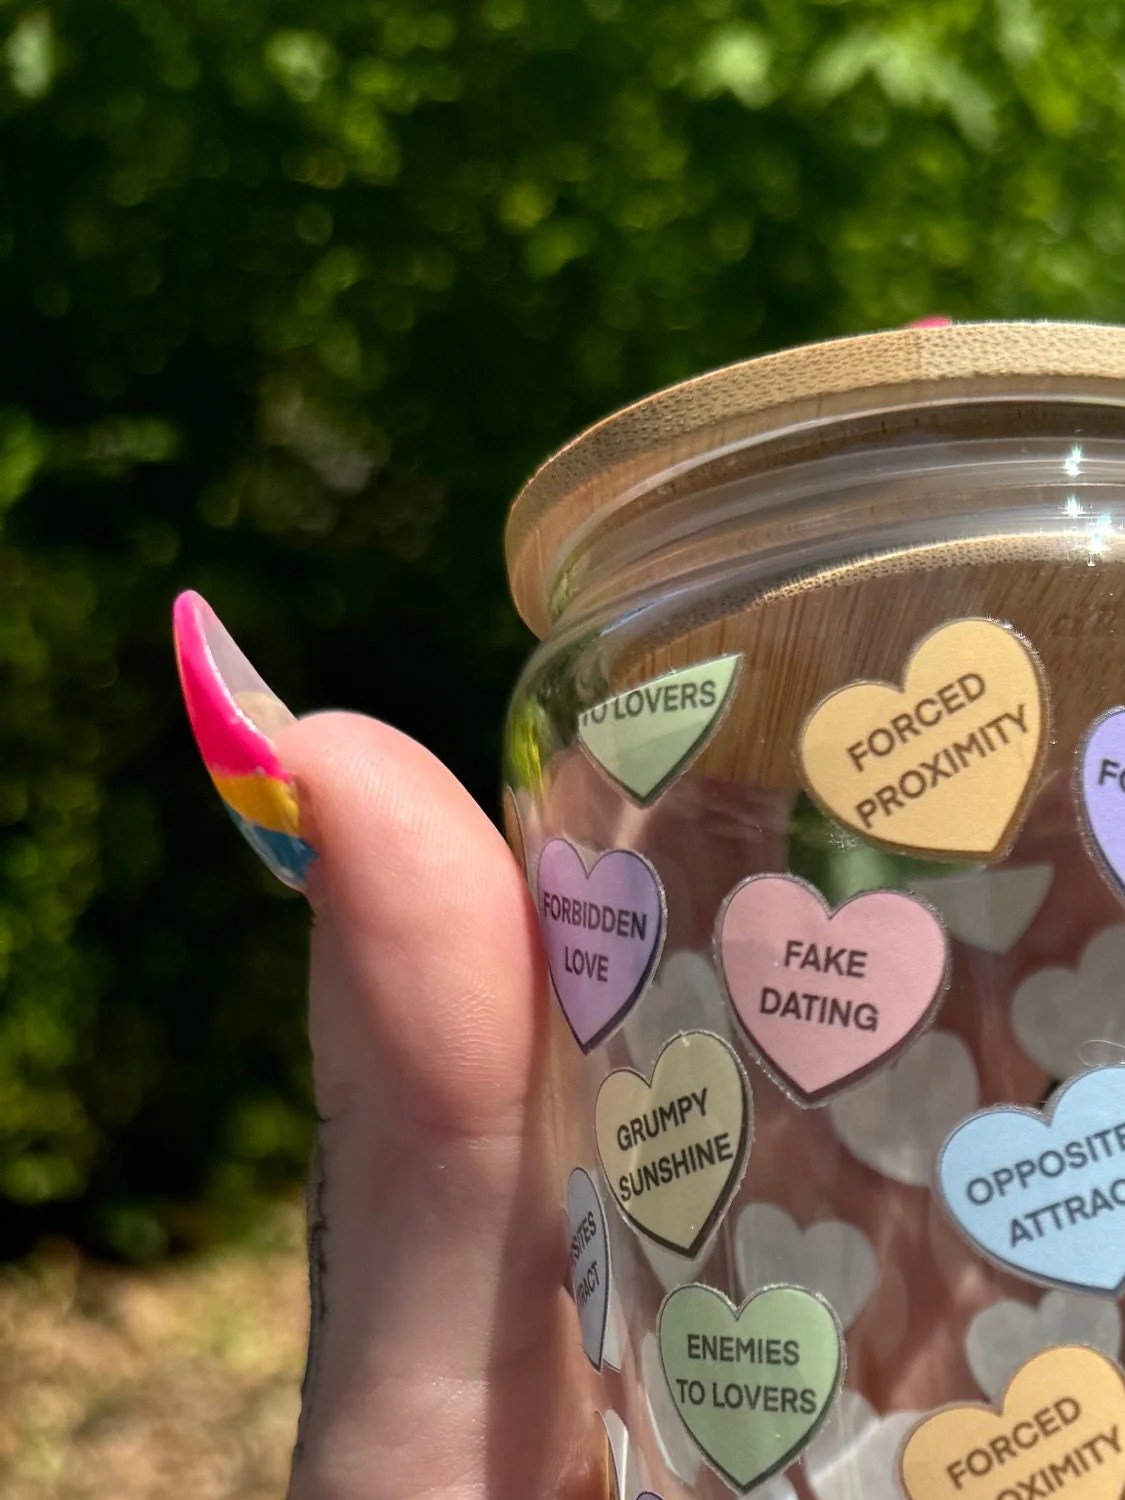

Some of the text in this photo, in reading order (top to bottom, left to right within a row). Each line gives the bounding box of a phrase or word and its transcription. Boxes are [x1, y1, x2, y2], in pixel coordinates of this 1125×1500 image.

[582, 680, 717, 727] O LOVERS
[848, 673, 986, 771] FORCED
[855, 705, 1030, 829] PROXIMITY
[543, 892, 647, 941] FORBIDDEN
[565, 946, 609, 983] LOVE
[783, 940, 868, 978] FAKE
[760, 987, 880, 1031] DATING
[616, 1088, 708, 1151] GRUMPY
[619, 1132, 733, 1202] SUNSHINE
[687, 1334, 800, 1366] ENEMIES
[677, 1379, 817, 1414] TO LOVERS
[946, 1397, 1081, 1489] FORCED
